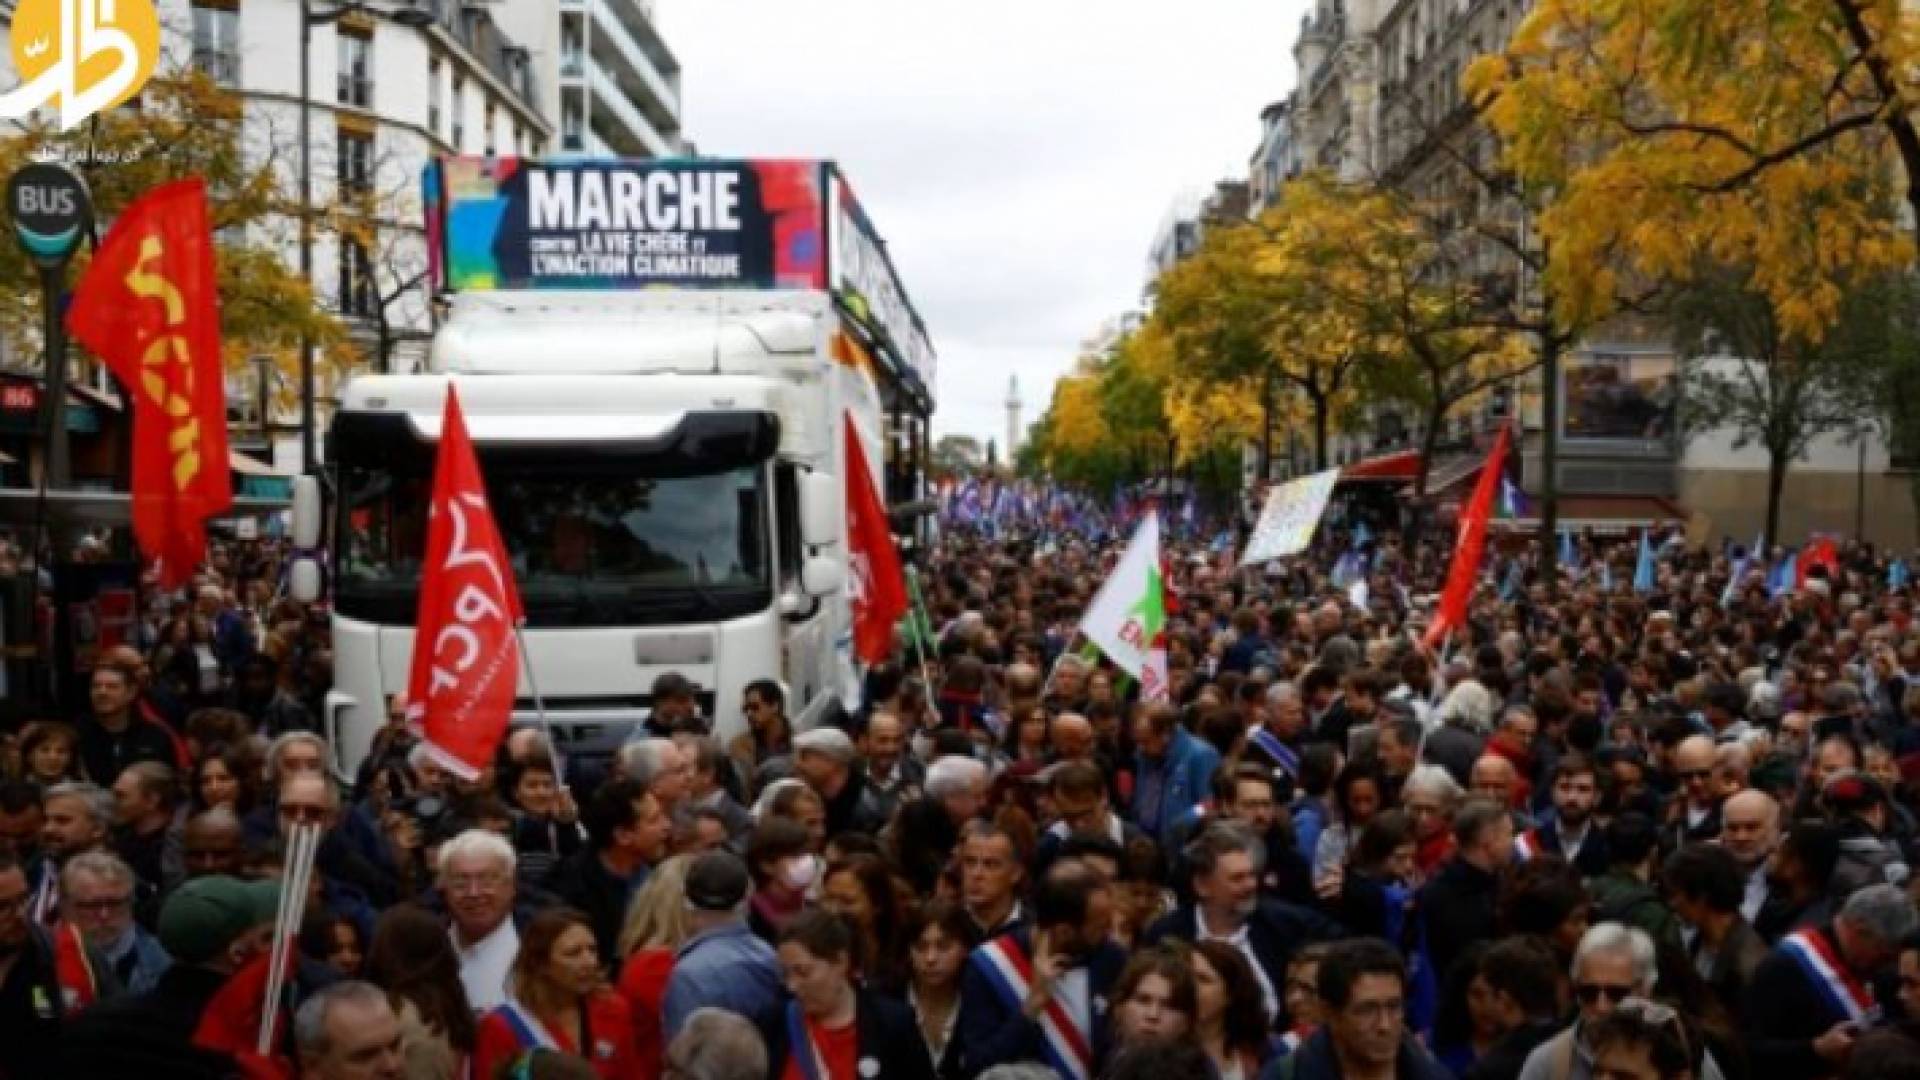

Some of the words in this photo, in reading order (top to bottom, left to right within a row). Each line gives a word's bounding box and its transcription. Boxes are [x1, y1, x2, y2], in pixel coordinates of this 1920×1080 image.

[17, 184, 75, 215] BUS
[528, 170, 741, 230] MARCHE
[580, 231, 602, 252] LA
[604, 231, 631, 252] VIE
[633, 254, 741, 278] CLIMATIQUE
